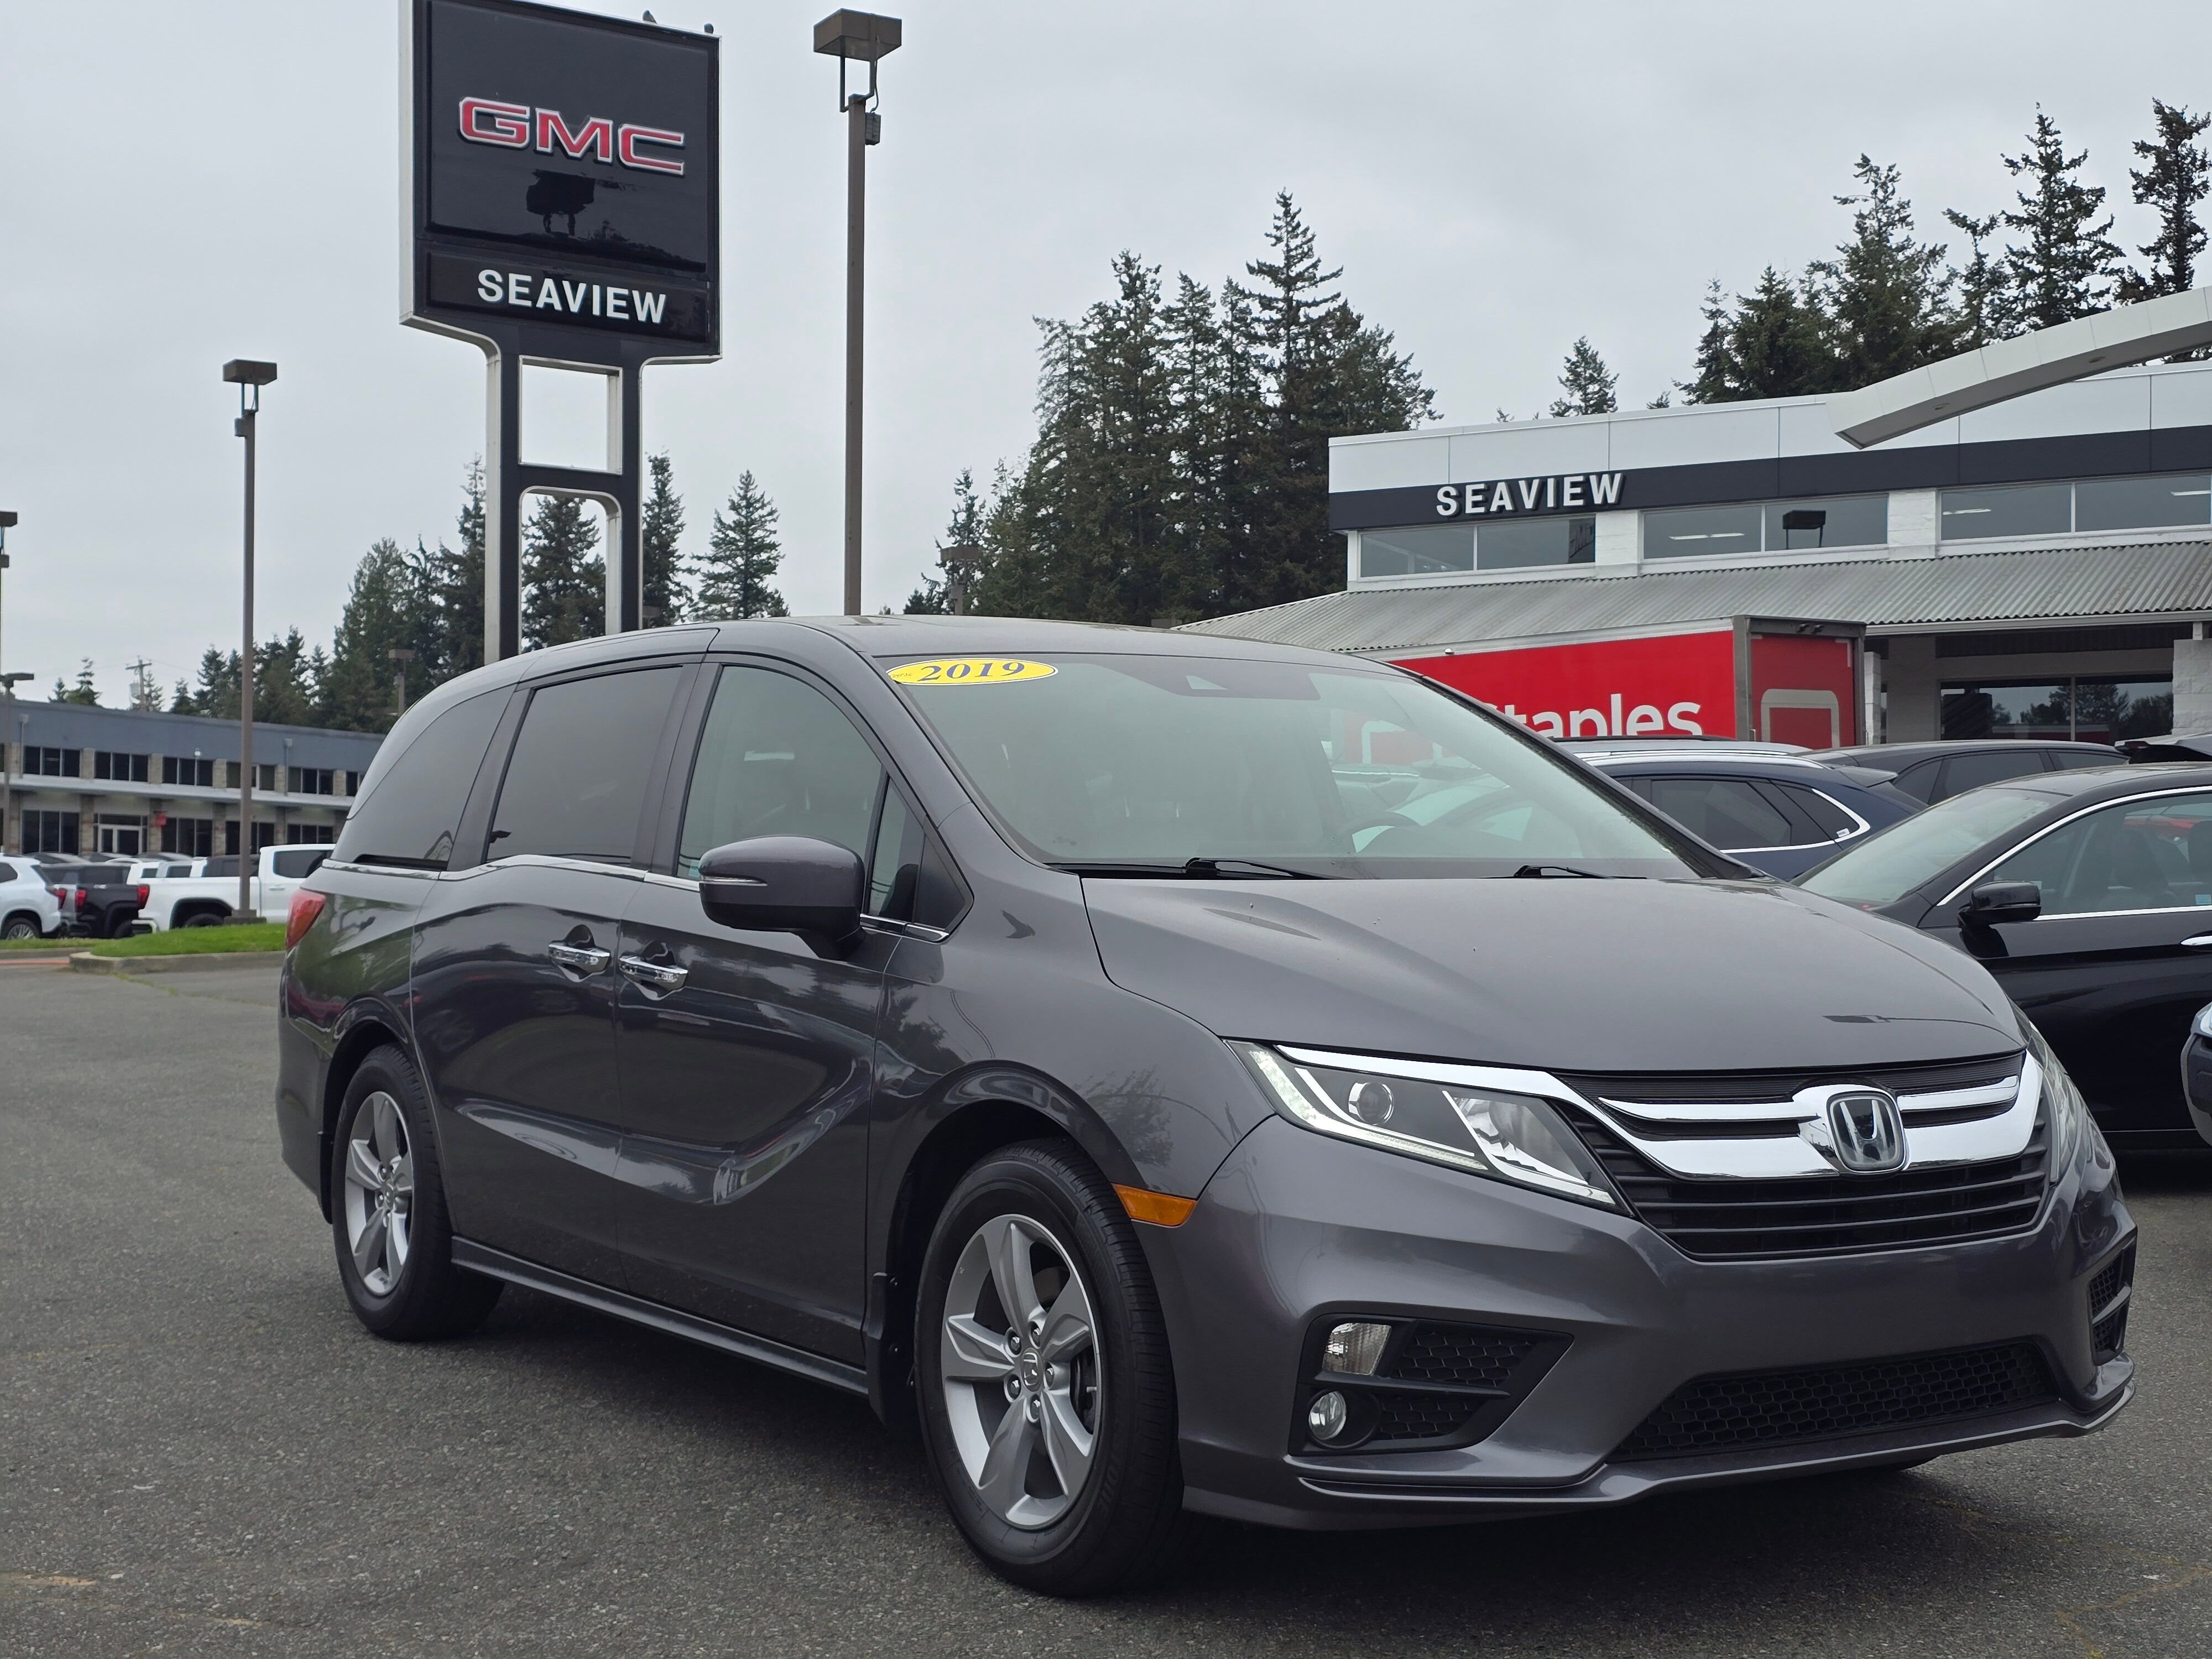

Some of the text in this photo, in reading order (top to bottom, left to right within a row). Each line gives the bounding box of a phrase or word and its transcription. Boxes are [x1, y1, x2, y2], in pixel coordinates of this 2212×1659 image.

[458, 96, 685, 176] GMC
[477, 269, 666, 324] SEAVIEW
[1436, 472, 1623, 517] SEAVIEW
[917, 661, 1025, 682] 2019
